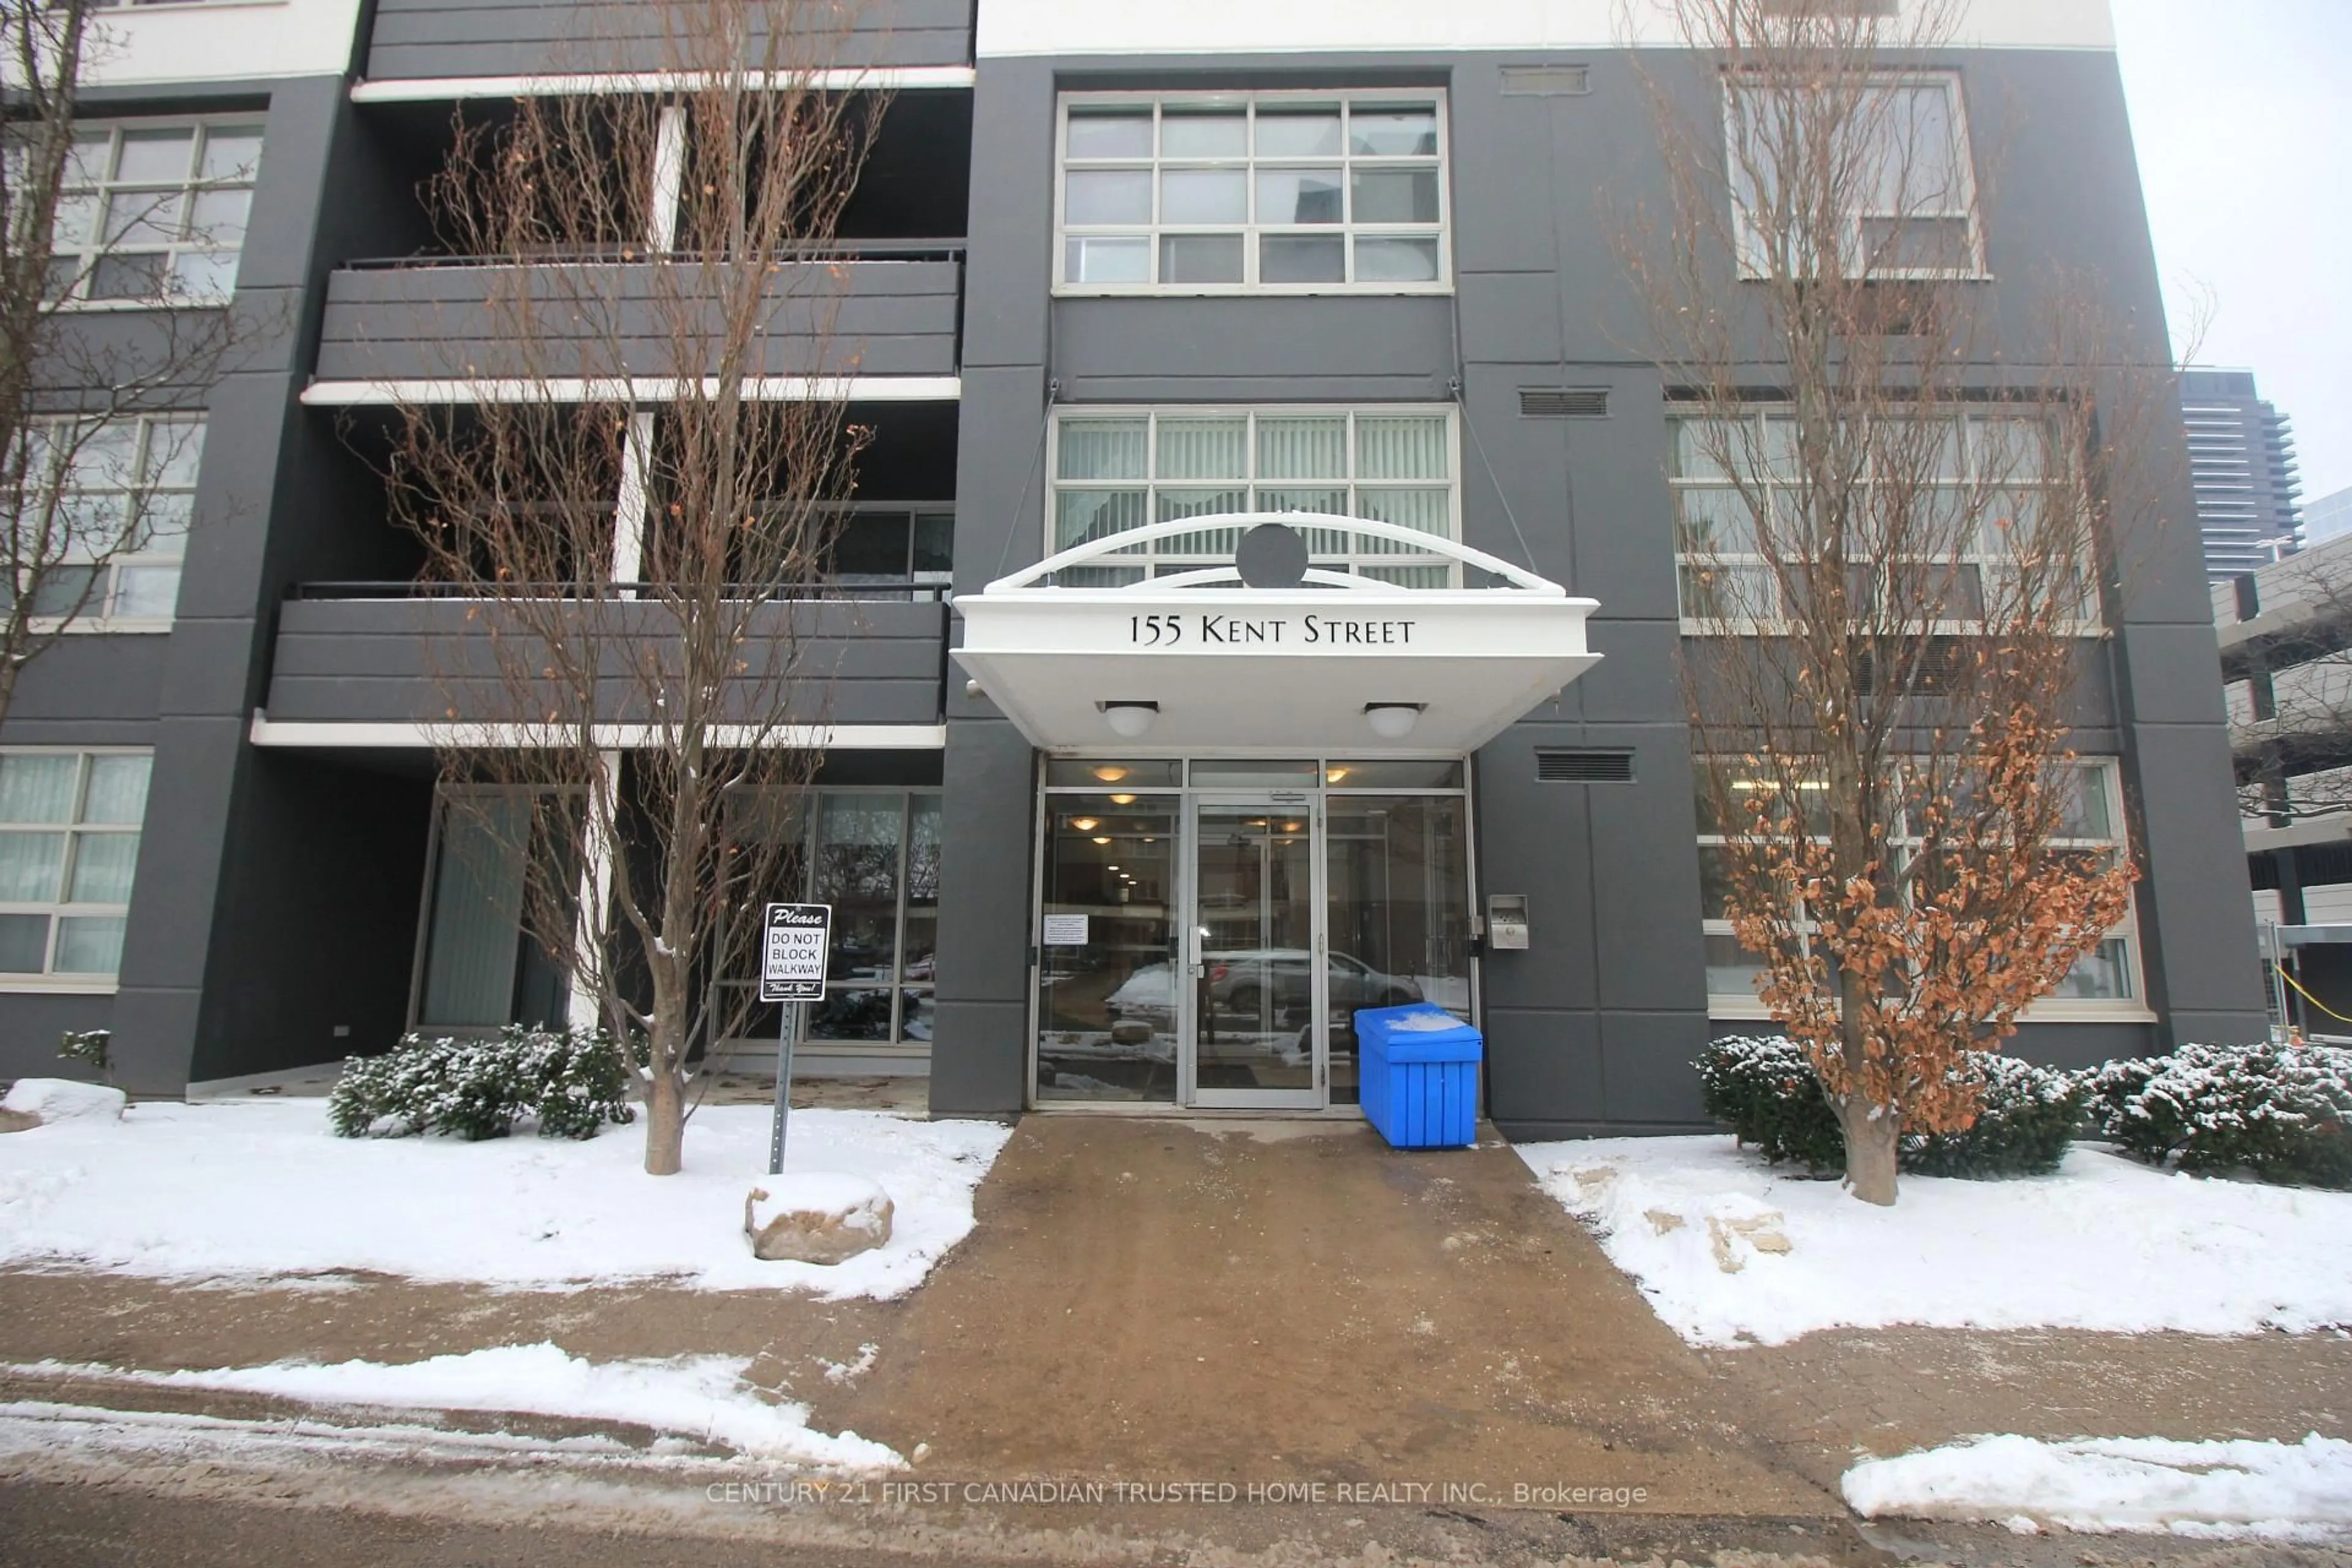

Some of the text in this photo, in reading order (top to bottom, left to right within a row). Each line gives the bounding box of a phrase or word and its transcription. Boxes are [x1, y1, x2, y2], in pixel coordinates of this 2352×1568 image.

[1130, 615, 1181, 646] 155
[774, 908, 823, 924] Please
[772, 933, 821, 944] DO NOT
[773, 949, 817, 960] BLOCK
[769, 964, 821, 974] WALKWAY
[769, 983, 793, 992] Thank
